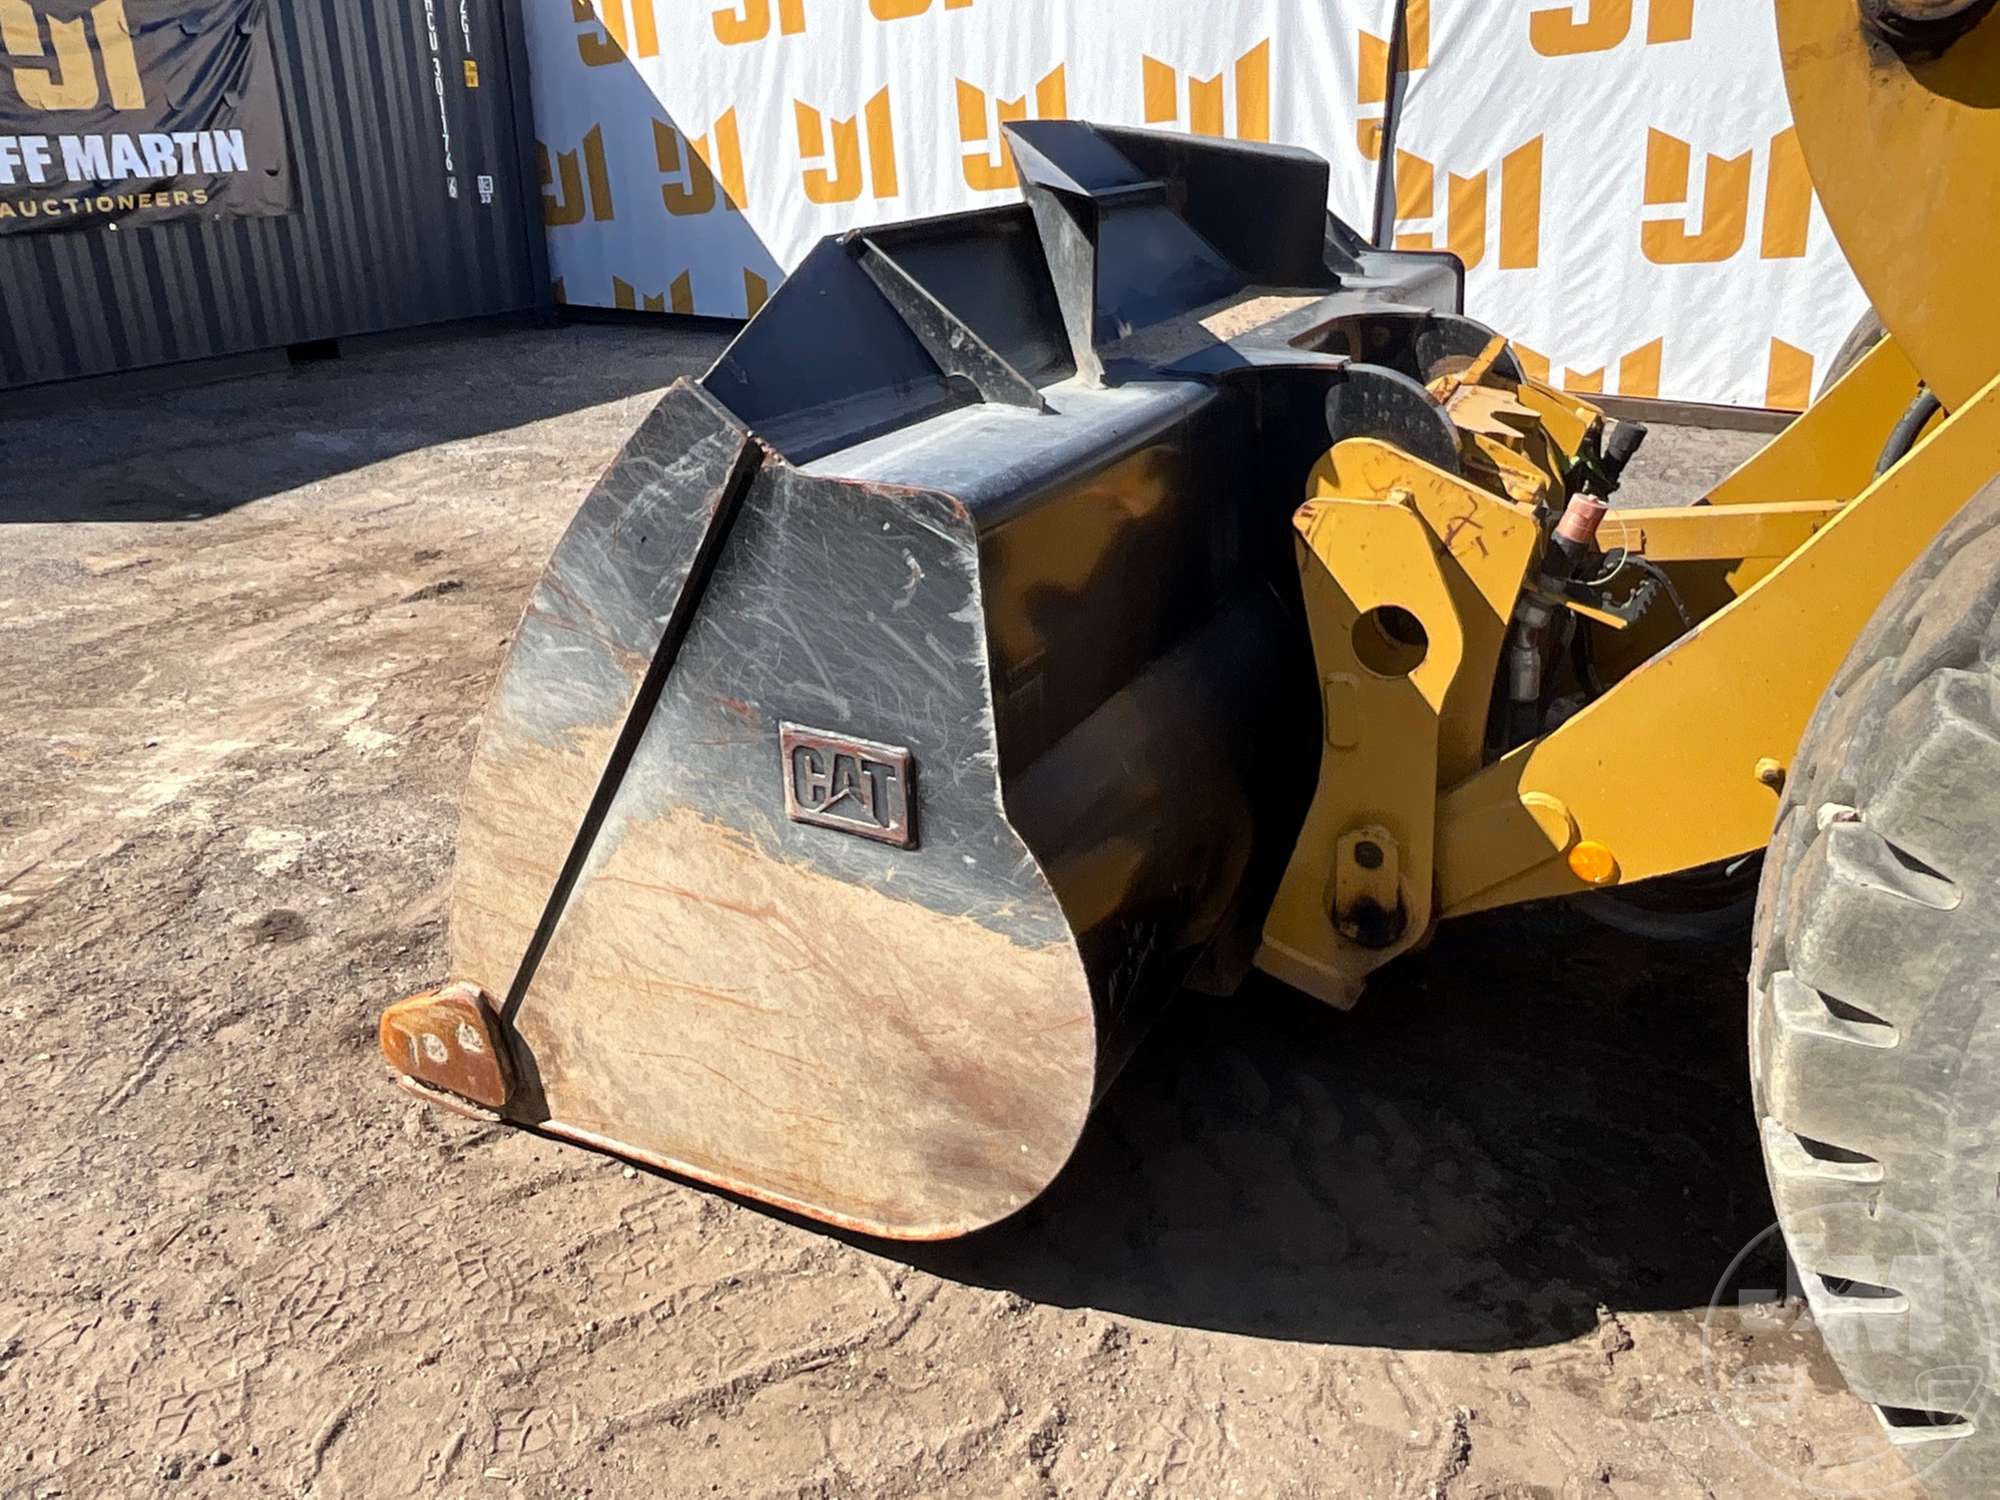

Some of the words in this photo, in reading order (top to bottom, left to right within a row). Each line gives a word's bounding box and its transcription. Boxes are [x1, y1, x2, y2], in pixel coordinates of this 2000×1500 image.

[59, 129, 248, 182] MARTIN
[0, 189, 209, 218] AUCTIONEERS
[792, 744, 897, 830] CAT
